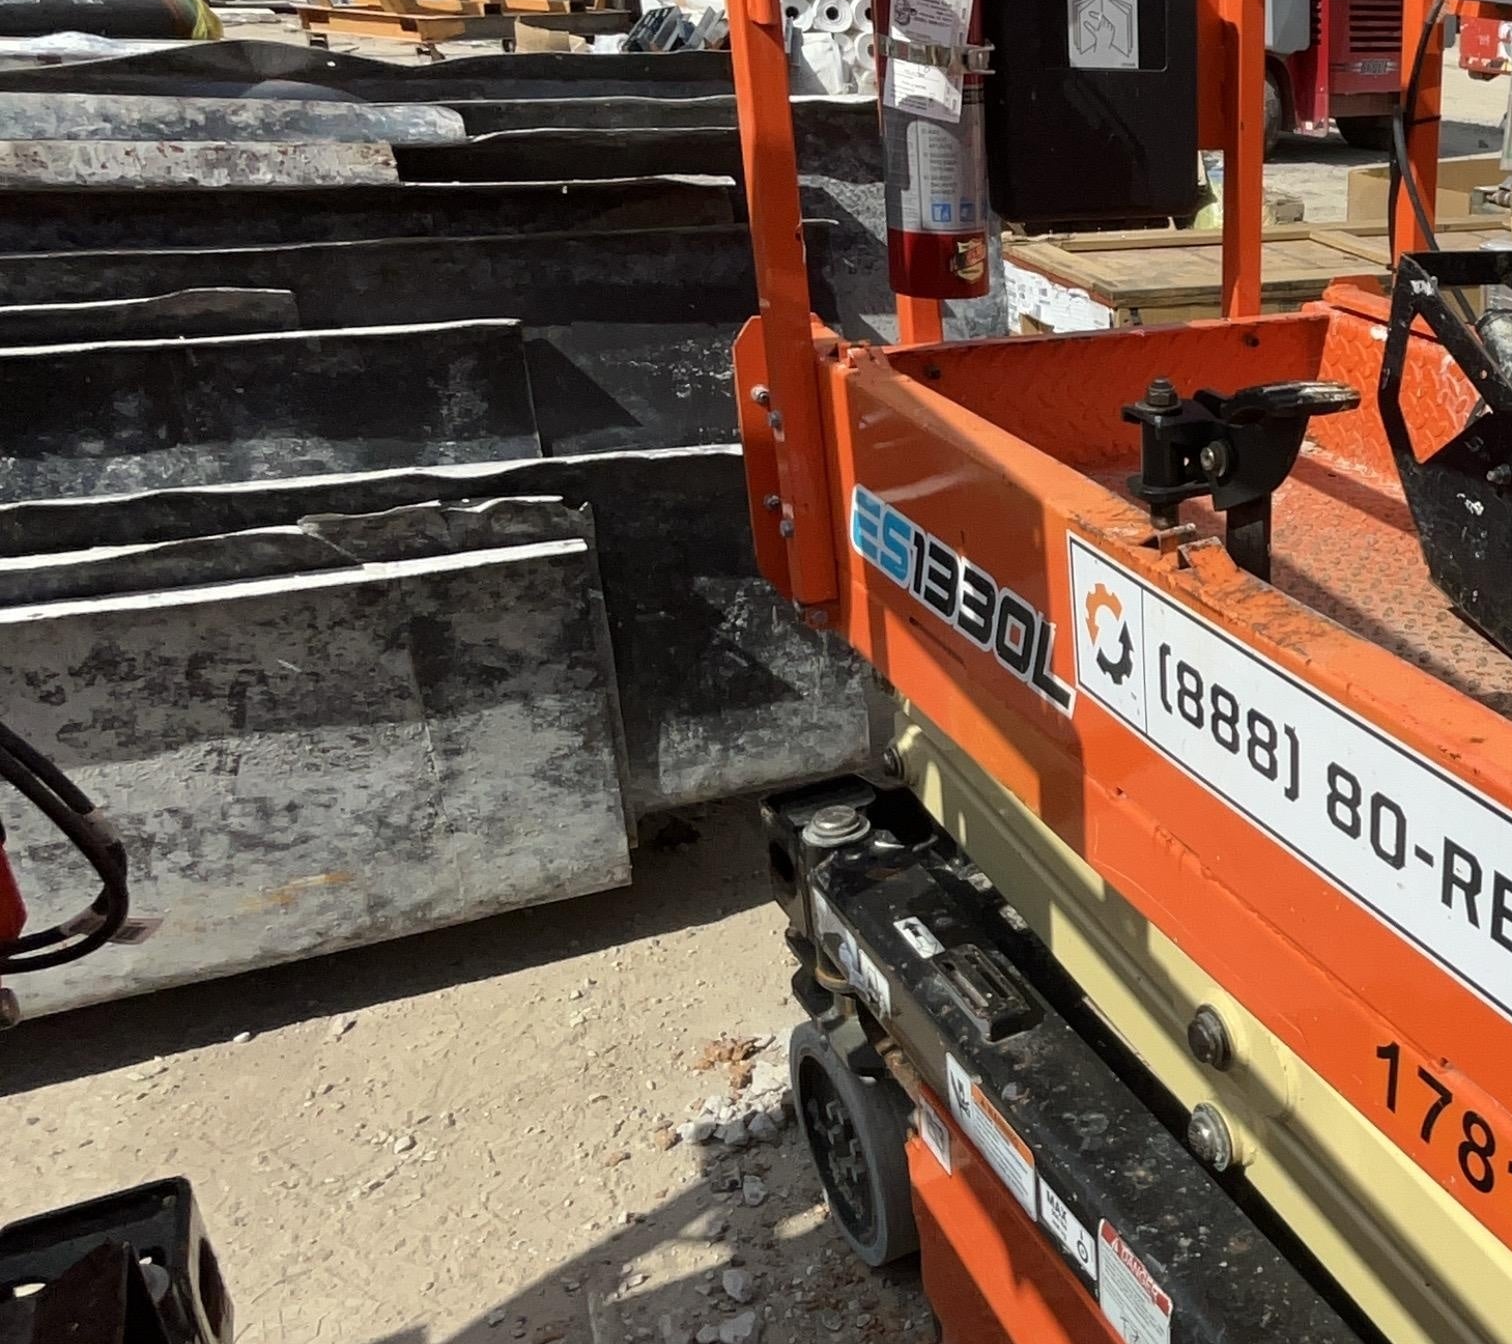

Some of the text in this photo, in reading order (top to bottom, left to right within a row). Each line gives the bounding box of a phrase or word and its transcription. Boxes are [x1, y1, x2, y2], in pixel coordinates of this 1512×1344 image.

[852, 486, 1074, 714] ES1330L
[1157, 639, 1301, 804] (888)
[1119, 1246, 1160, 1300] DANGER
